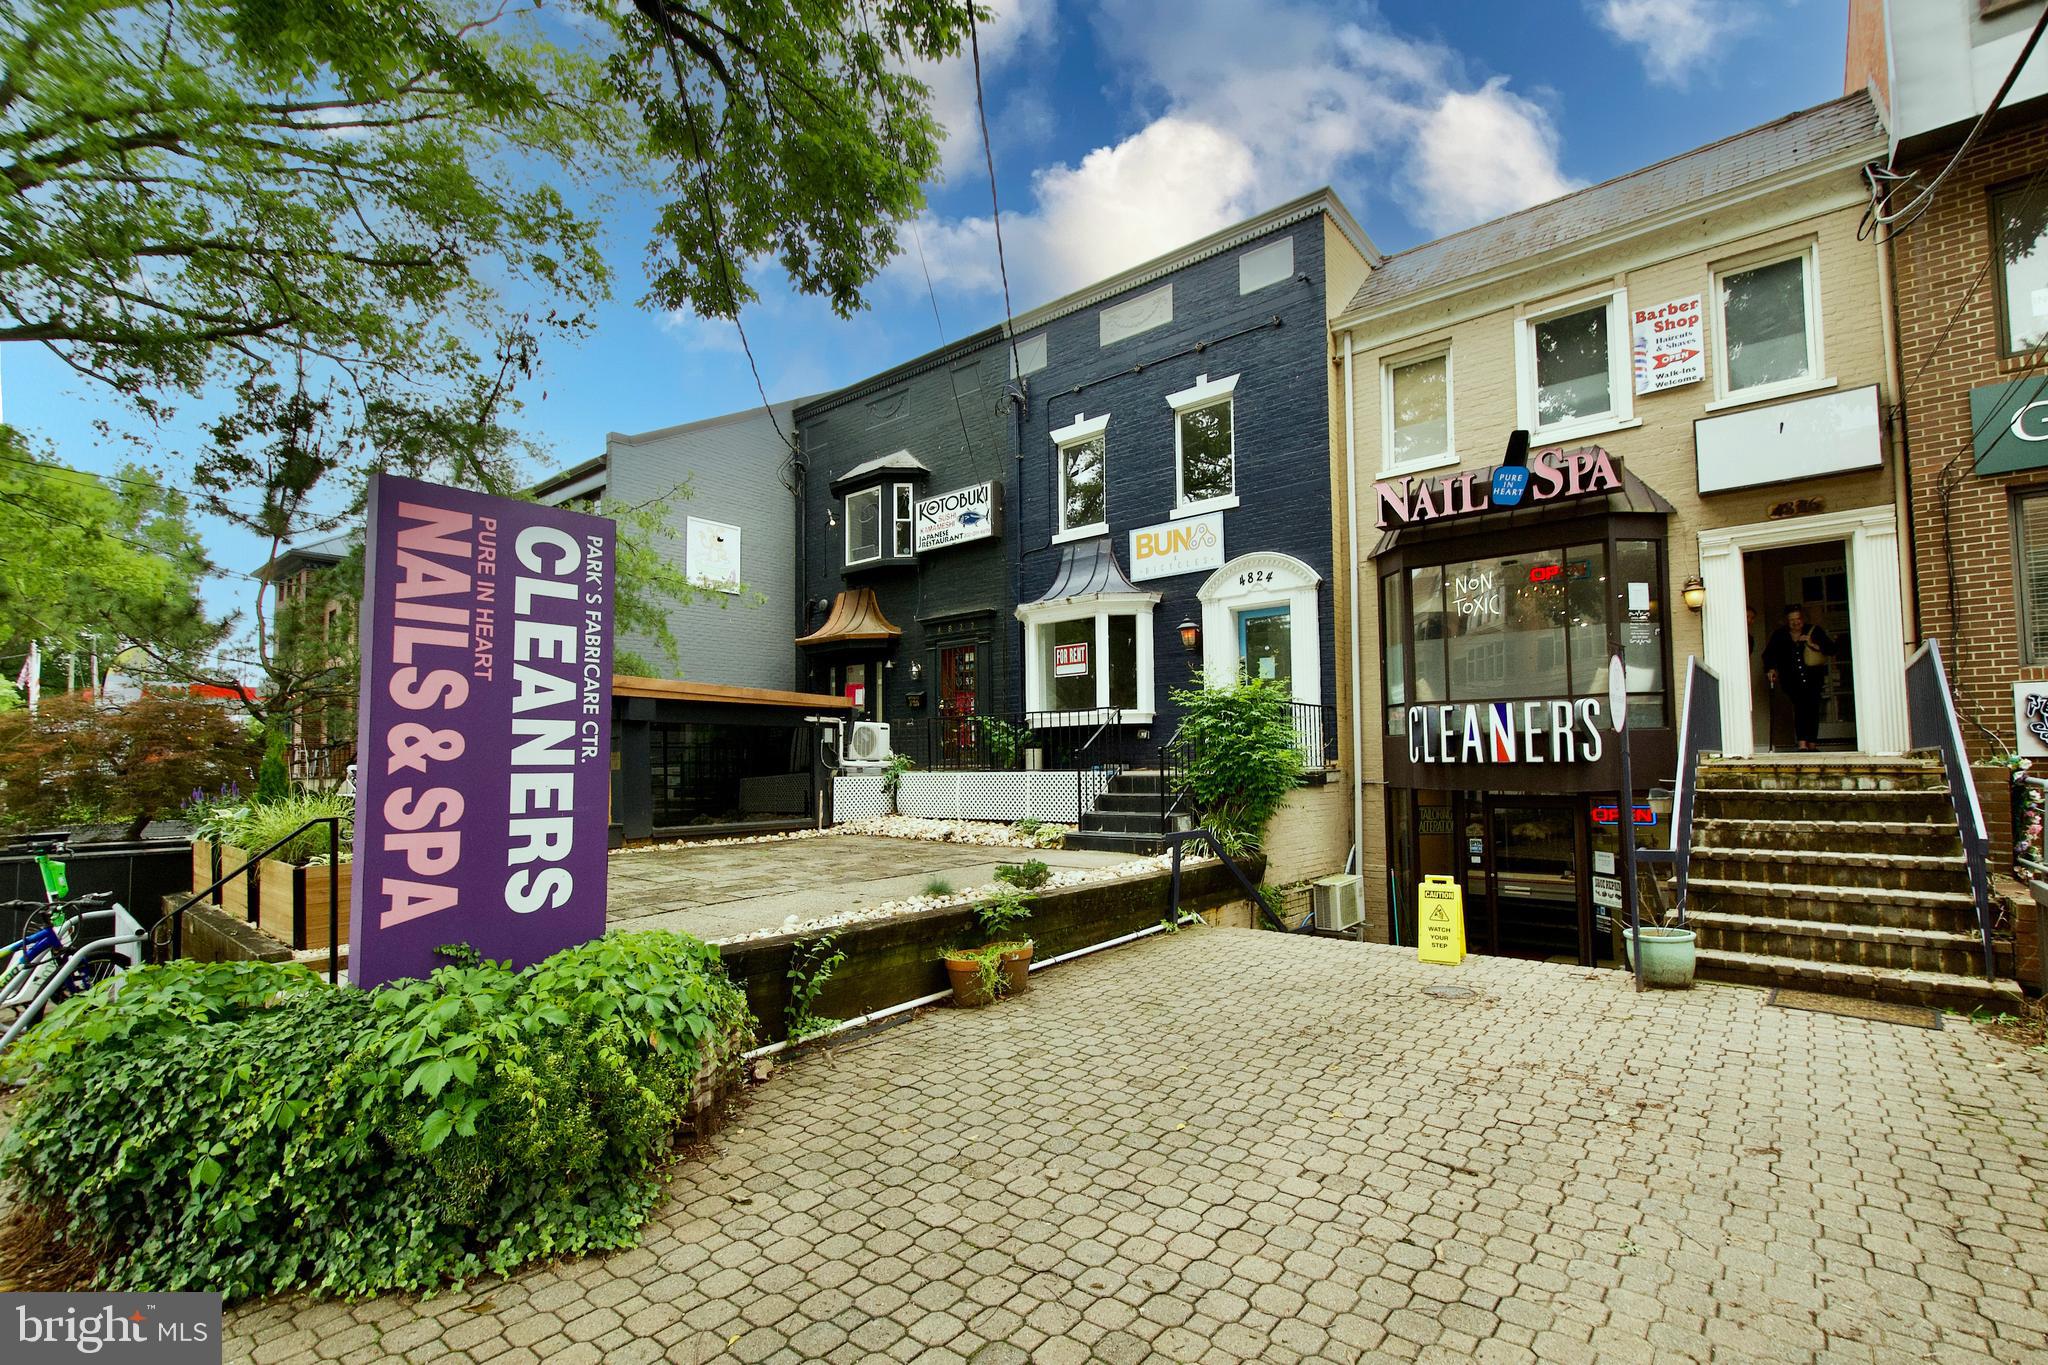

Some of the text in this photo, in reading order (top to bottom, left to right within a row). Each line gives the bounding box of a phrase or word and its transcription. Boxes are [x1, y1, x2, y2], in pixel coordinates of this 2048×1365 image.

[1635, 300, 1698, 324] Barber
[1654, 314, 1699, 333] Shop
[1656, 331, 1693, 344] Haircuts
[1666, 339, 1697, 350] Shaves
[1662, 350, 1689, 363] OPEN
[1655, 375, 1697, 388] Welcome
[1499, 473, 1523, 481] PURE
[1373, 447, 1622, 528] NAIL SPA
[1493, 487, 1524, 496] HEART
[920, 486, 988, 524] KOTOBUKI
[919, 530, 949, 546] JAPANESE
[922, 533, 964, 547] RESTAURANT
[1239, 570, 1273, 586] 4824
[474, 514, 497, 682] PURE IN HEART
[583, 610, 602, 714] FABRICARE
[1057, 646, 1086, 664] FOR RENT
[379, 501, 471, 930] NAILS & SPA
[504, 525, 582, 914] CLEANERS
[1408, 698, 1602, 763] CLEANERS
[581, 721, 600, 763] CTR.
[1591, 807, 1653, 822] OPN
[1425, 890, 1454, 899] CAUTION
